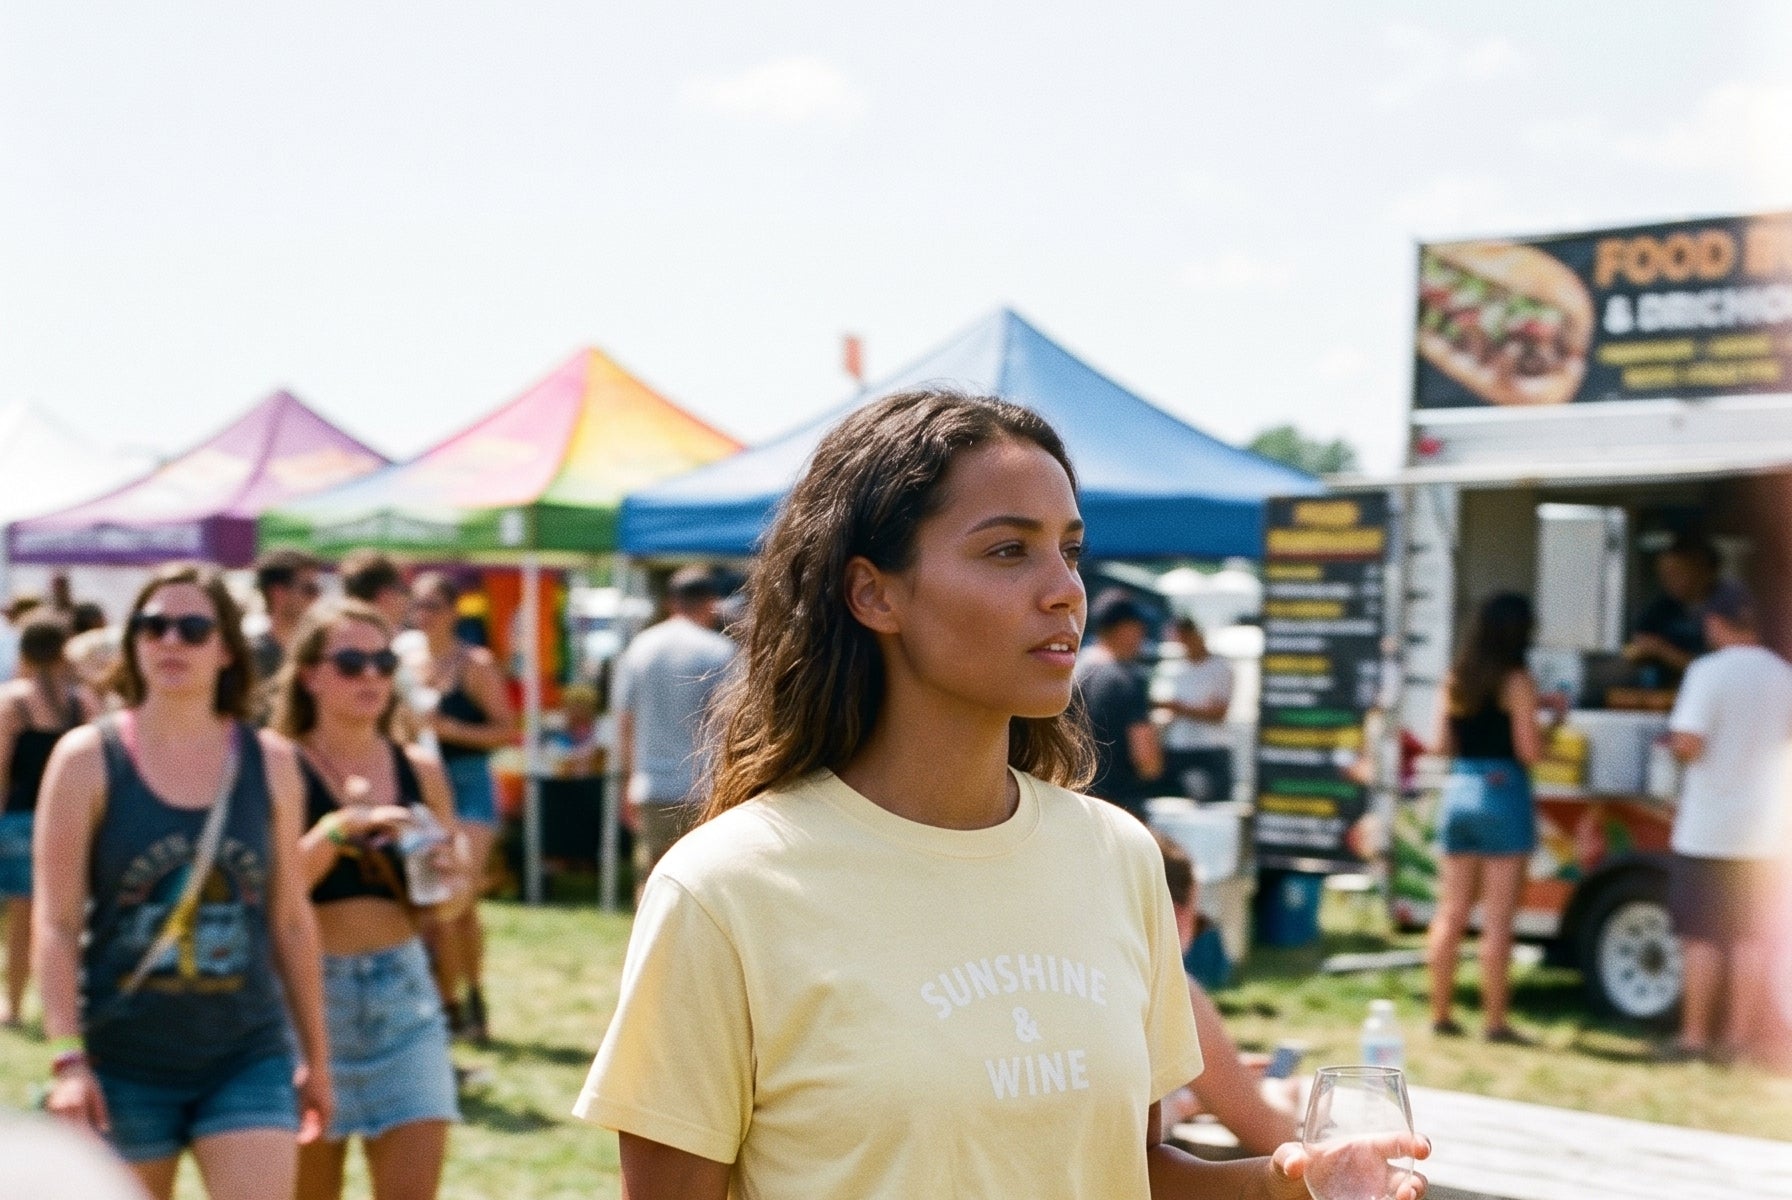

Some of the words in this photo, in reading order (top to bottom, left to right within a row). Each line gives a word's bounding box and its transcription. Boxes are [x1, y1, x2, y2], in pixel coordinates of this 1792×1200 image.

[1595, 229, 1735, 287] FOOD
[920, 954, 1107, 1020] SUNSHINE
[1011, 1006, 1042, 1043] &
[984, 1049, 1090, 1100] WINE
